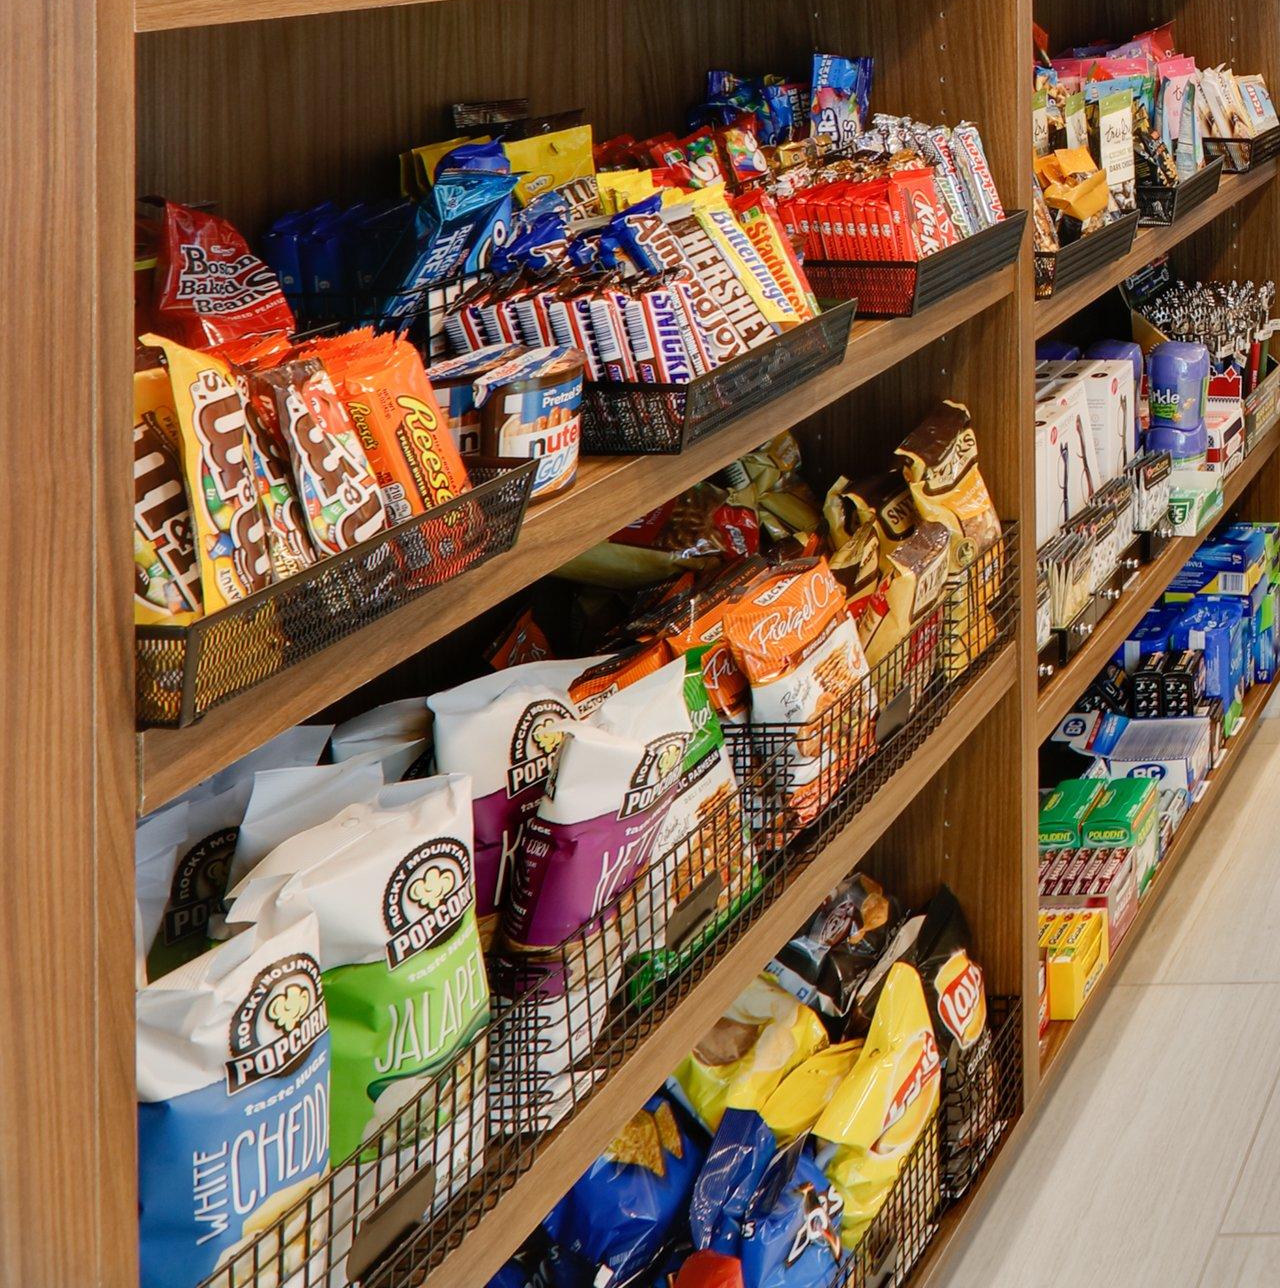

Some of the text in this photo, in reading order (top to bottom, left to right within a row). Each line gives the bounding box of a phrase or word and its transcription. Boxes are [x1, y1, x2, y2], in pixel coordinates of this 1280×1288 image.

[708, 212, 795, 315] Butterfinger
[542, 389, 575, 408] Pretzel
[347, 401, 379, 451] Reese's
[399, 433, 416, 471] PEANUT
[749, 598, 816, 655] Pretzel
[577, 688, 617, 715] FACTORY
[514, 713, 533, 760] ROCKY
[688, 751, 721, 784] PARMESAN
[405, 842, 470, 874] MOUNTAIN
[1088, 830, 1126, 840] POLIDENT
[388, 869, 408, 929] ROCKY
[393, 882, 473, 963] POPCORN
[262, 958, 323, 996] MOUNTAIN
[407, 951, 448, 983] taste
[237, 981, 268, 1051] ROCKY
[234, 1000, 329, 1087] POPCORN
[243, 1049, 327, 1117] taste HUGE
[192, 1140, 230, 1246] WHITE
